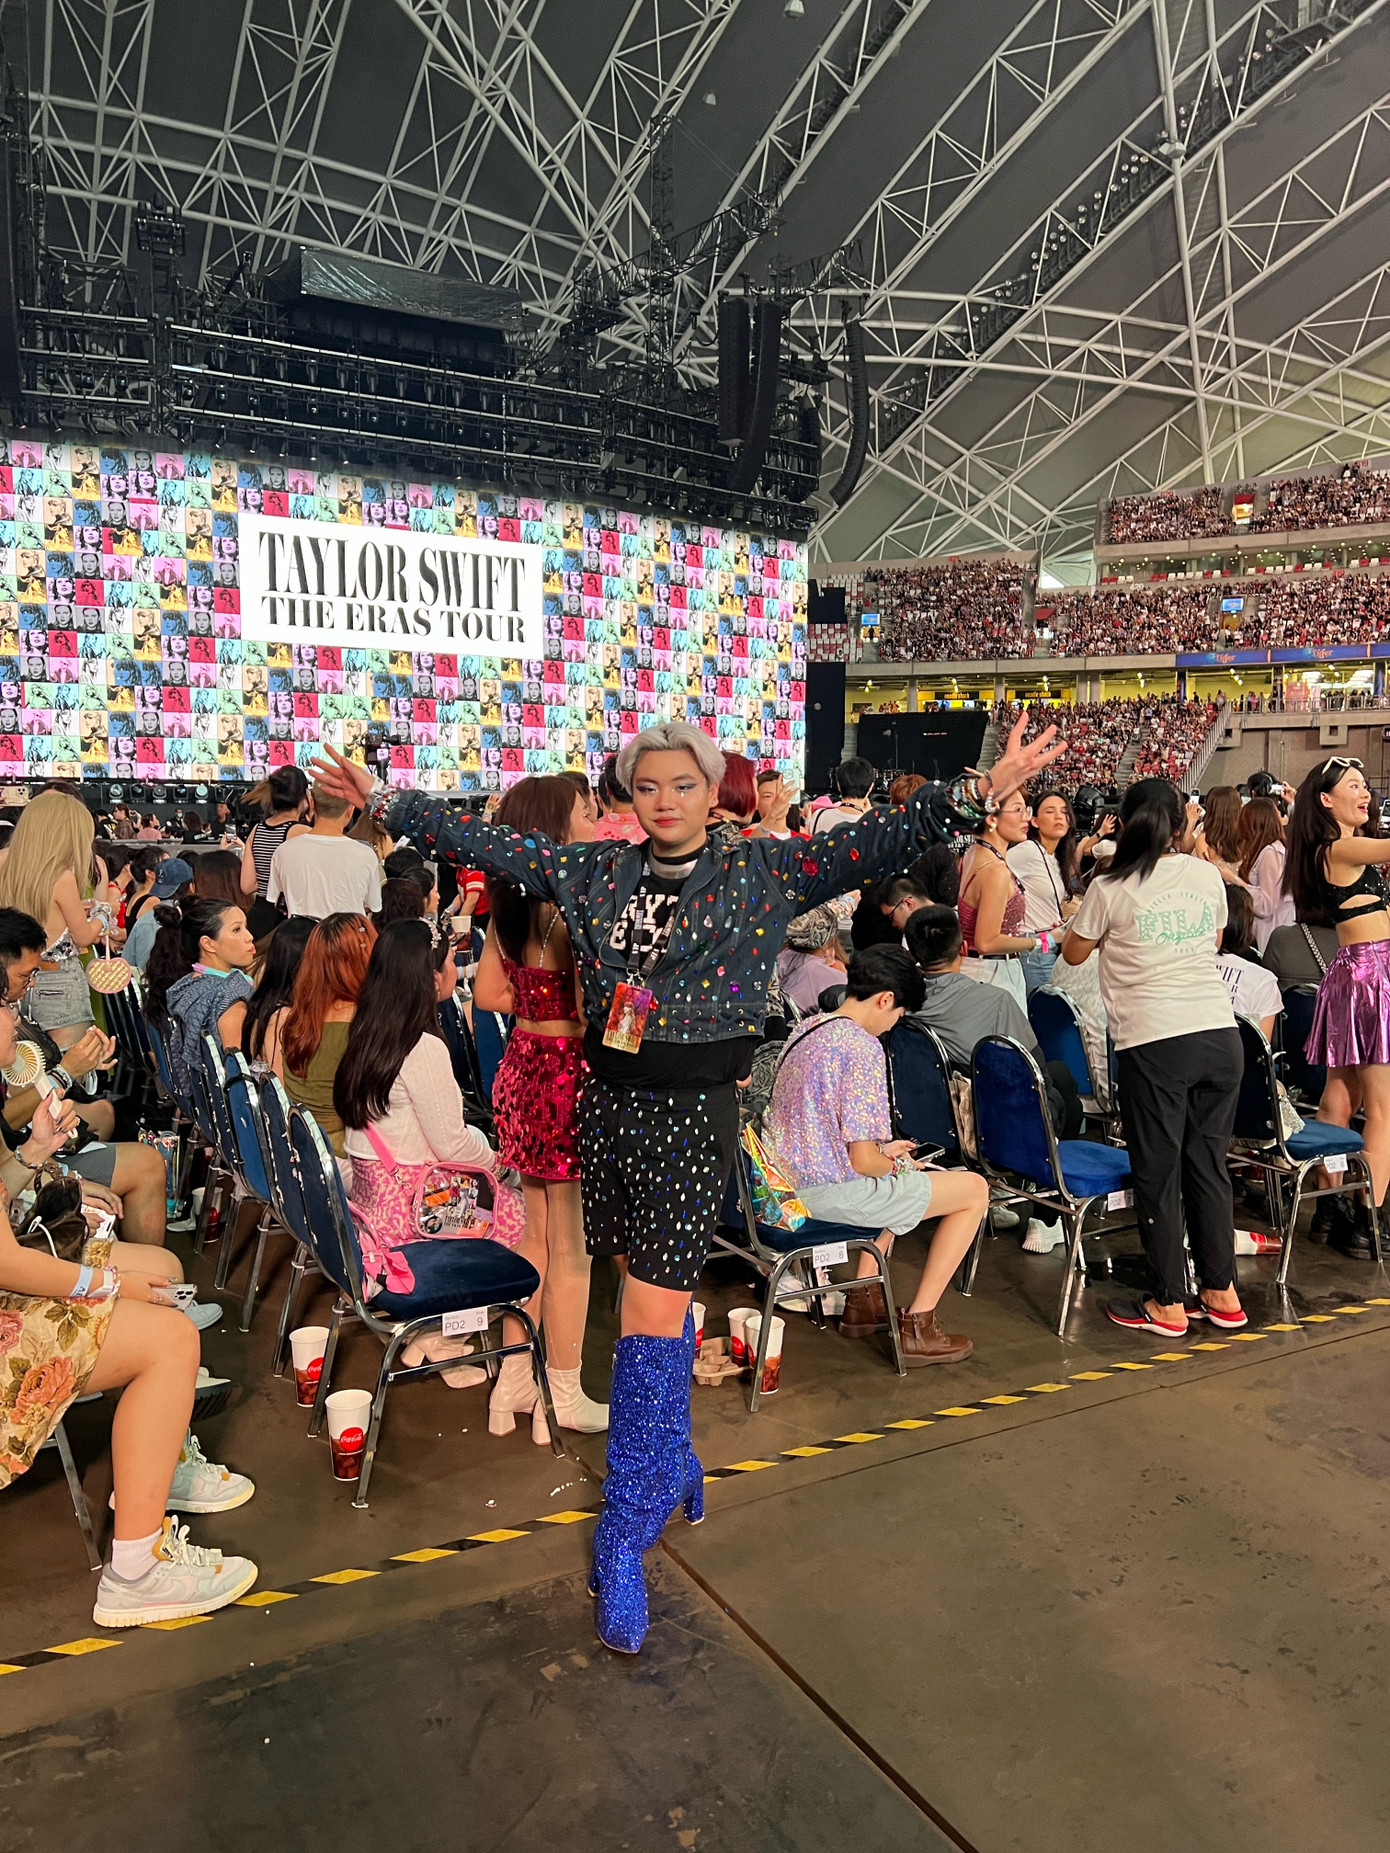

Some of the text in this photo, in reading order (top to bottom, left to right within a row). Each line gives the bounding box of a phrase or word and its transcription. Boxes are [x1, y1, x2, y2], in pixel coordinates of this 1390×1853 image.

[259, 531, 525, 612] TAYLOR SWIFT
[261, 596, 527, 643] THE ERAS TOUR
[1215, 653, 1236, 663] Tiger
[1312, 649, 1333, 659] Tiger
[1136, 902, 1215, 941] FILA
[445, 1317, 484, 1332] PD2 9
[340, 1433, 362, 1443] Coca-Cola
